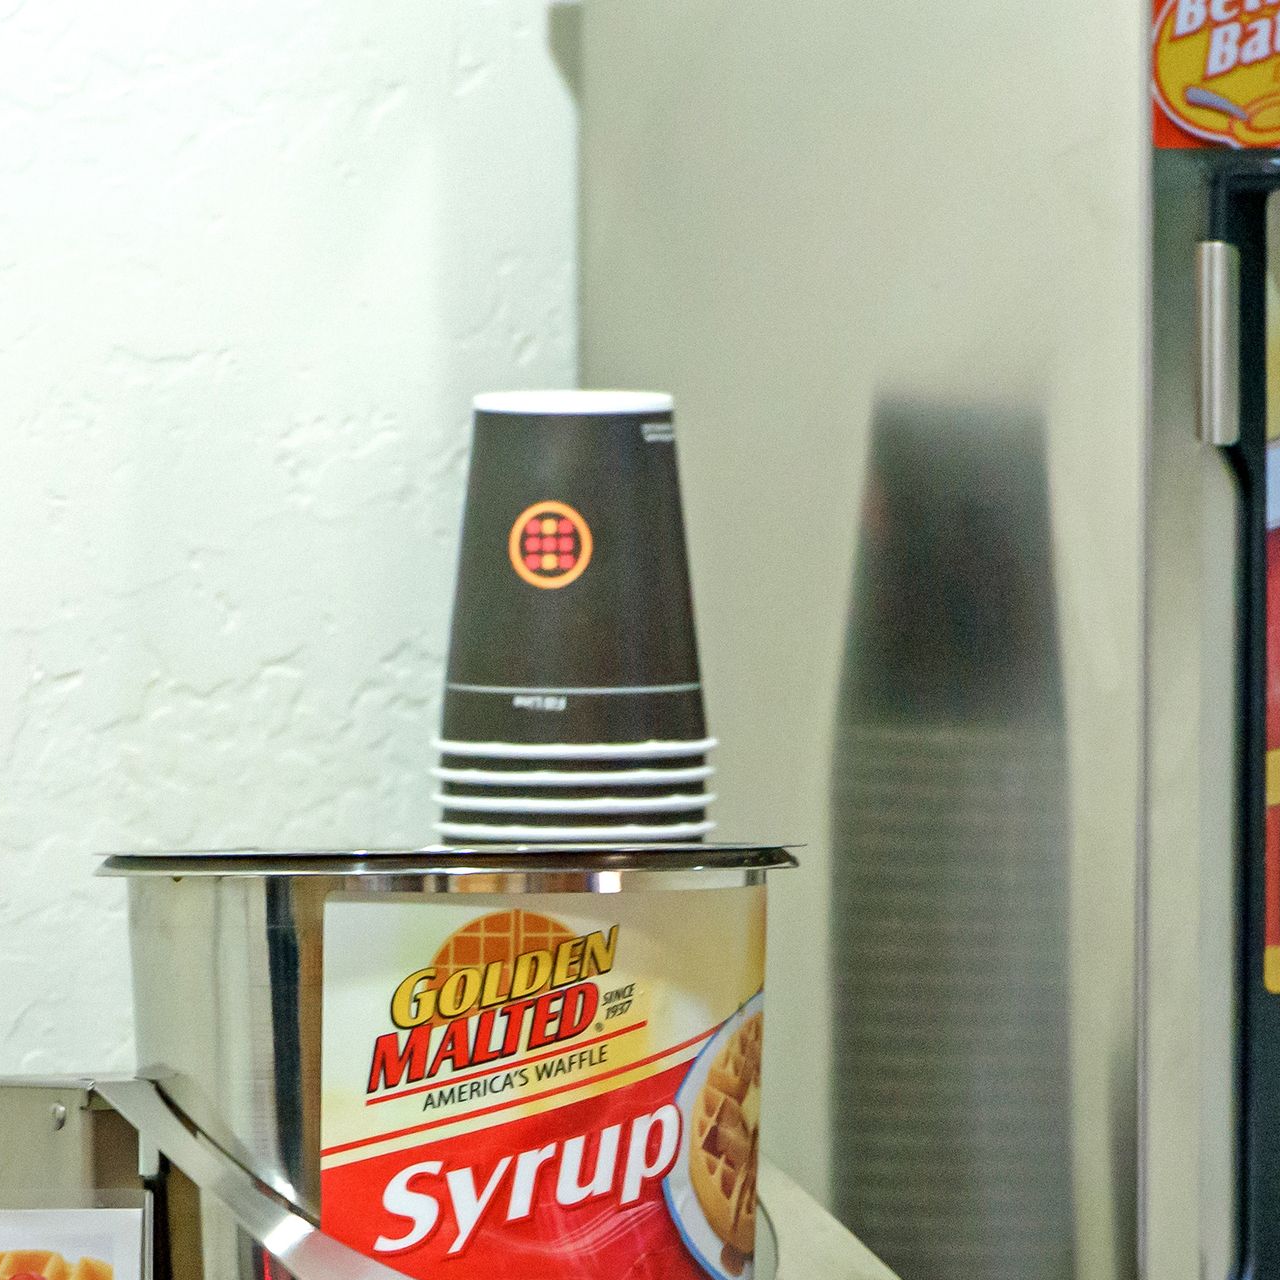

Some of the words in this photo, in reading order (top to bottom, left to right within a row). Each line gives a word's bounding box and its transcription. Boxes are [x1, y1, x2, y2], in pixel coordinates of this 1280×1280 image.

[390, 924, 620, 1030] GOLDEN
[602, 982, 637, 1006] SINCE
[604, 999, 633, 1022] 1937
[366, 981, 599, 1094] MALTED
[422, 1069, 530, 1112] AMERICA'S
[535, 1044, 609, 1081] WAFFLE
[373, 1104, 681, 1254] Syrup
